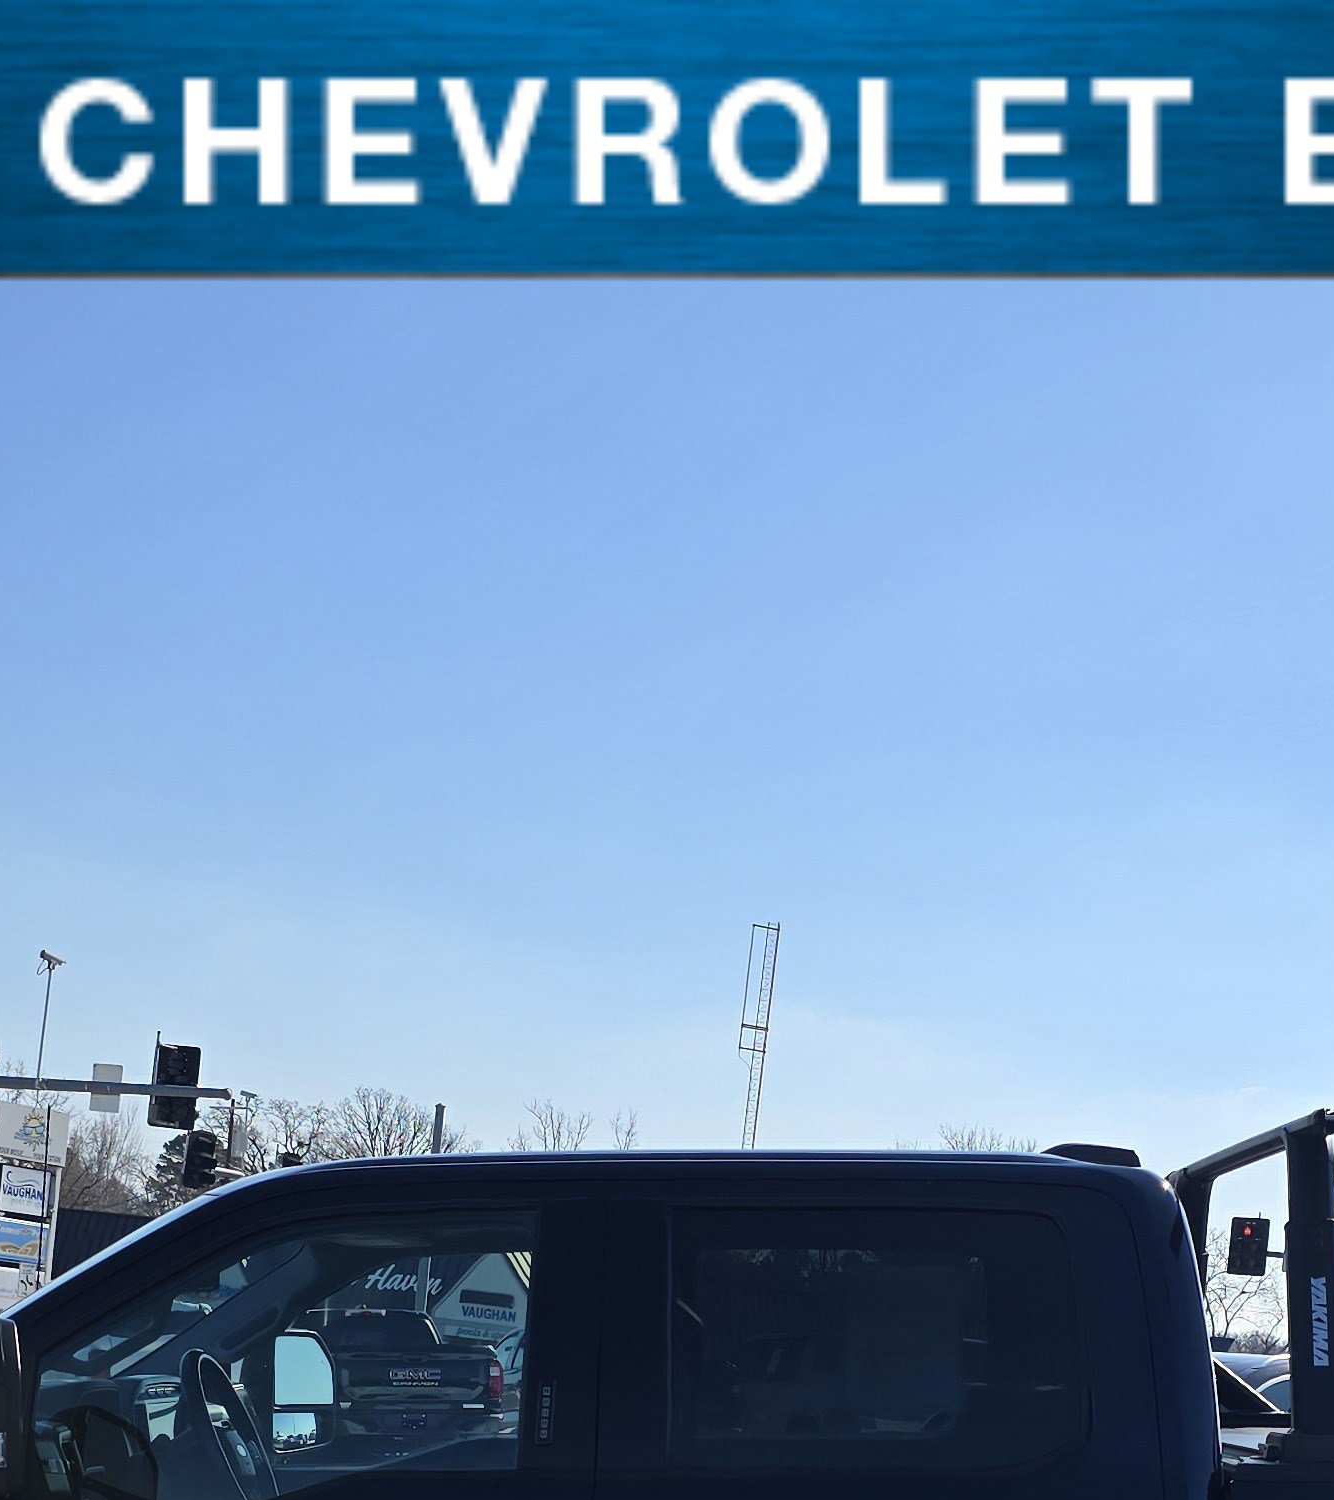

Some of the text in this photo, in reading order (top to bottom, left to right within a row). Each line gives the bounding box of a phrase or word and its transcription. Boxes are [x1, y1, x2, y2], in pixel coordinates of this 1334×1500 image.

[2, 1184, 43, 1201] VAUGHAN
[364, 1264, 443, 1296] Havn
[461, 1305, 518, 1323] VAUGHAN
[1310, 1276, 1330, 1367] YAKIMA
[389, 1369, 441, 1380] GMC
